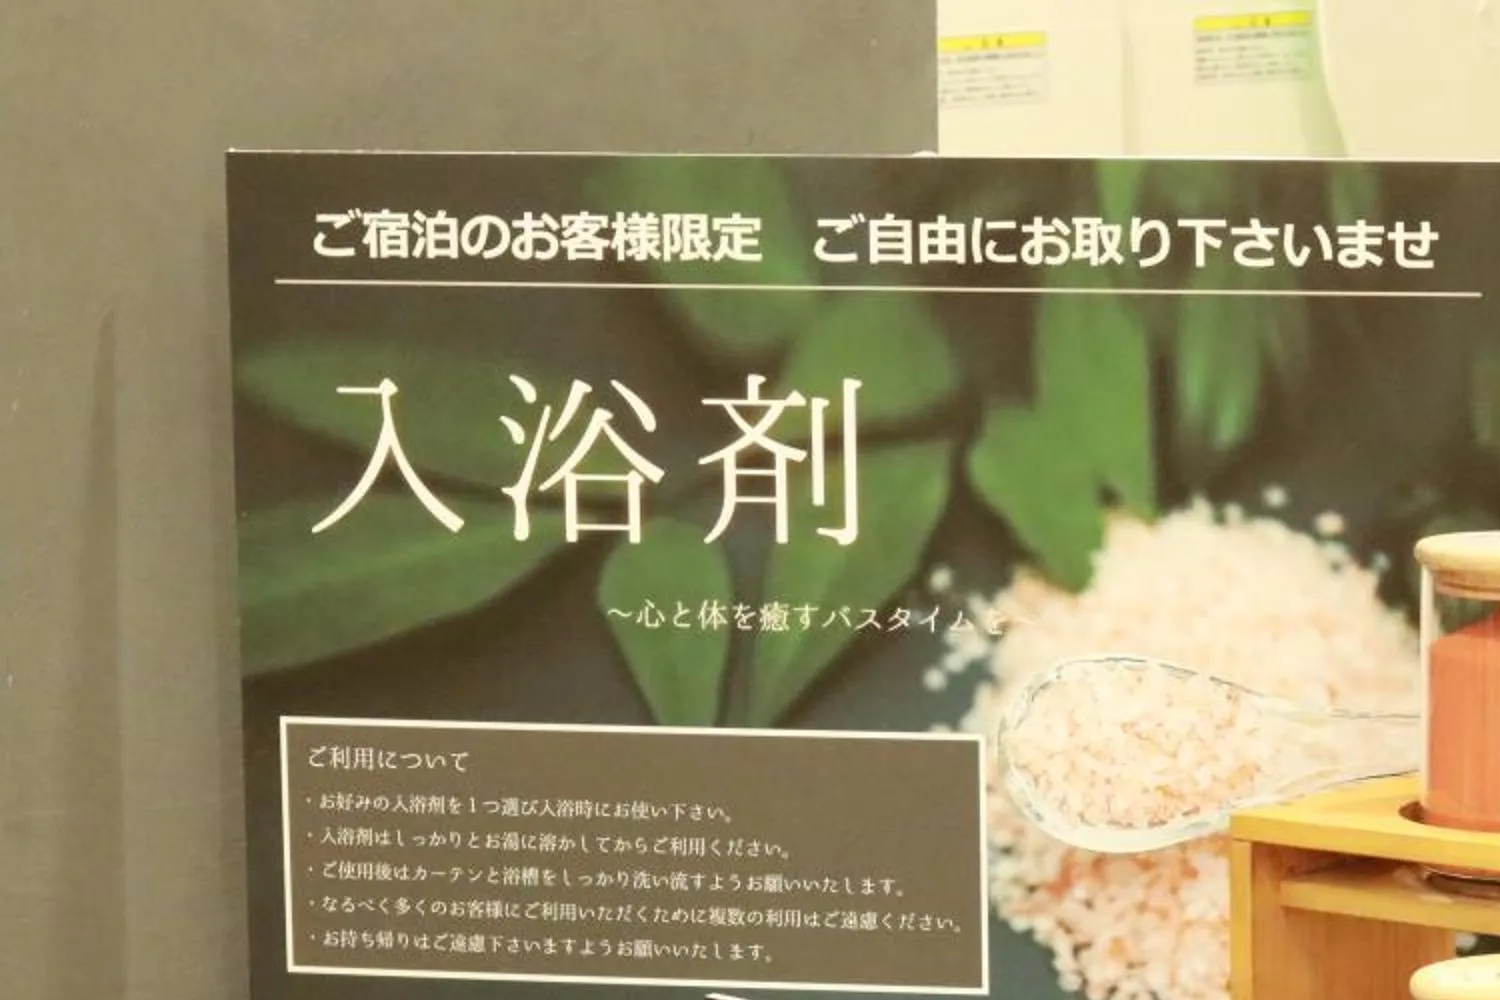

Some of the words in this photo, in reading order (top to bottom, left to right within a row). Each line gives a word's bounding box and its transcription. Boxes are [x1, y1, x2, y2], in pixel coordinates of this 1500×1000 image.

[313, 208, 762, 262] ご宿泊のお客様限定
[812, 213, 1440, 269] ご自由にお取り下さいませ
[311, 373, 863, 545] 入浴剤
[308, 745, 470, 773] ご利用について
